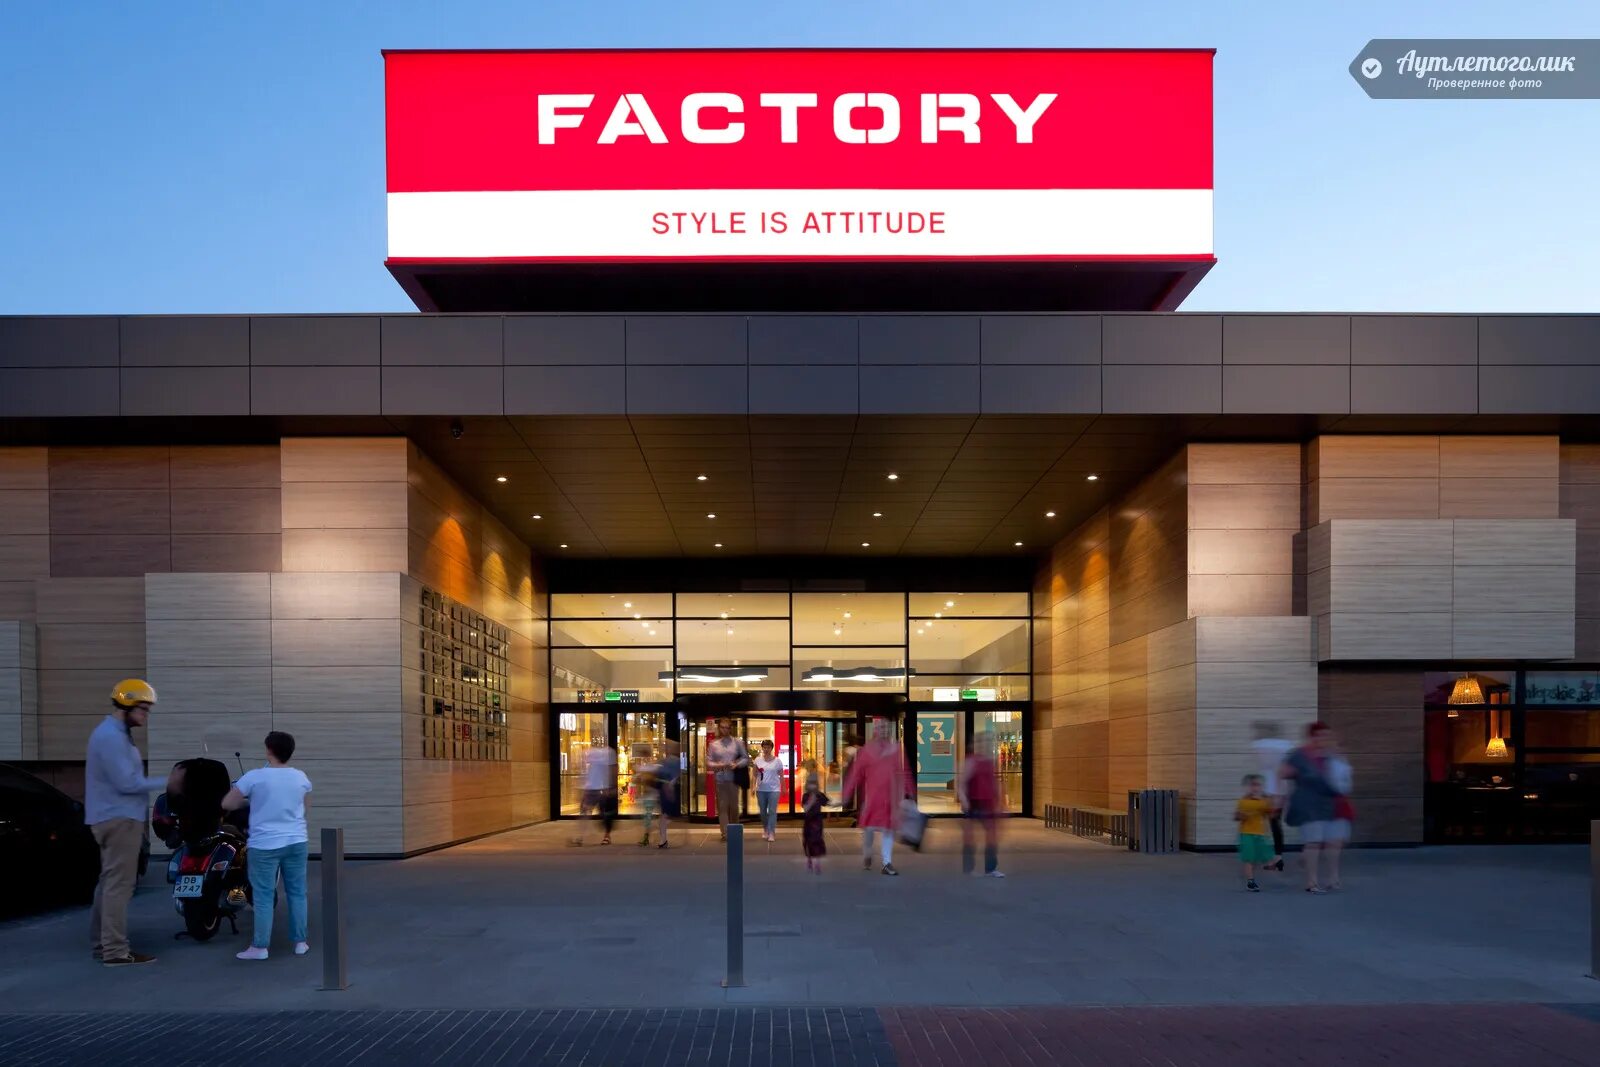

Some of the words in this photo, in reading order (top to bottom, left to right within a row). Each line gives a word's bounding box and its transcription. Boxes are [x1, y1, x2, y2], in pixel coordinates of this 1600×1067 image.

[537, 92, 1058, 145] FACTORY
[652, 211, 746, 235] STYLE
[761, 211, 788, 235] IS
[802, 211, 945, 235] ATTITUDE
[184, 876, 197, 884] DB
